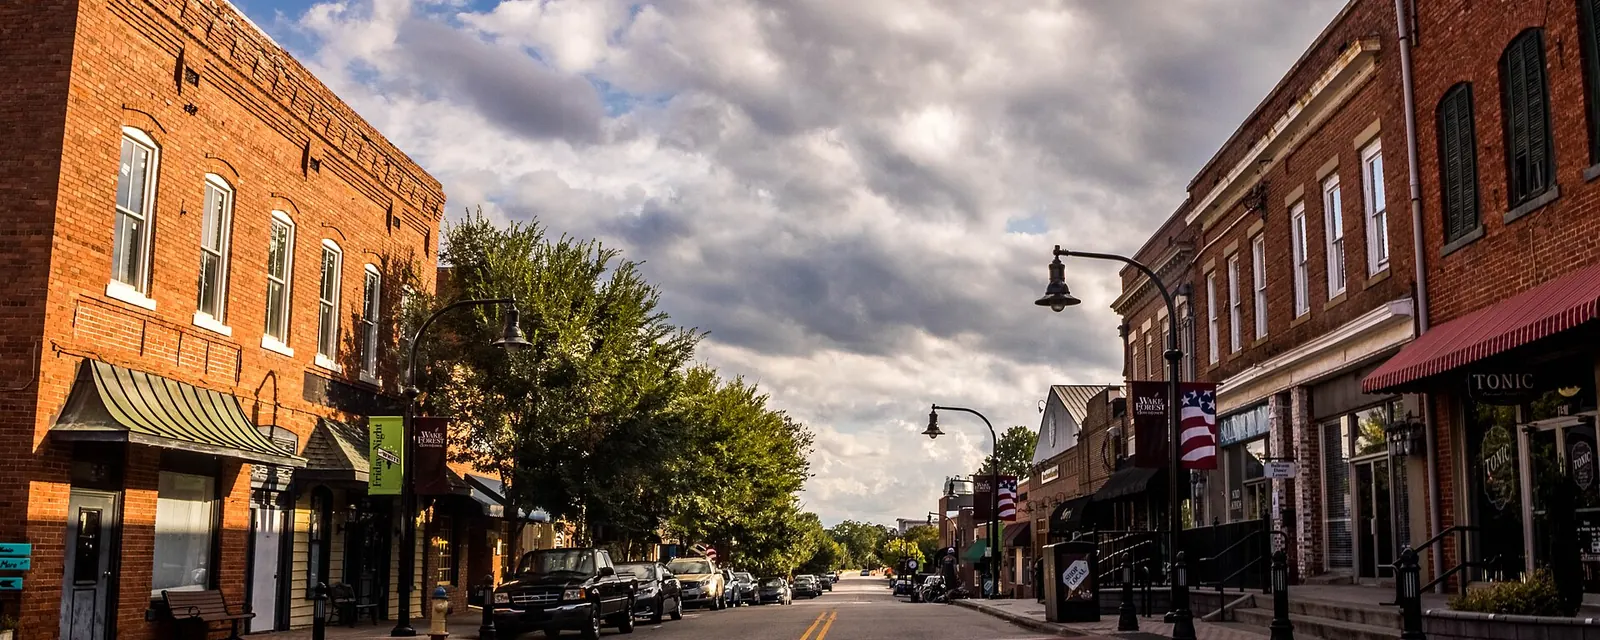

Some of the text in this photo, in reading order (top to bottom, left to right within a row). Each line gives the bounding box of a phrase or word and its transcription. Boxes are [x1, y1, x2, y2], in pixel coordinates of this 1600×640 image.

[1473, 373, 1534, 390] TONIC
[1135, 402, 1165, 411] FOREST
[1139, 396, 1163, 404] WAKE
[418, 436, 444, 444] FOREST
[373, 424, 385, 487] Friday Night
[1484, 443, 1510, 474] TONIC
[1573, 451, 1591, 469] TONIC
[0, 560, 17, 568] More
[1065, 566, 1078, 581] SHOP
[1069, 568, 1086, 586] LOCAL
